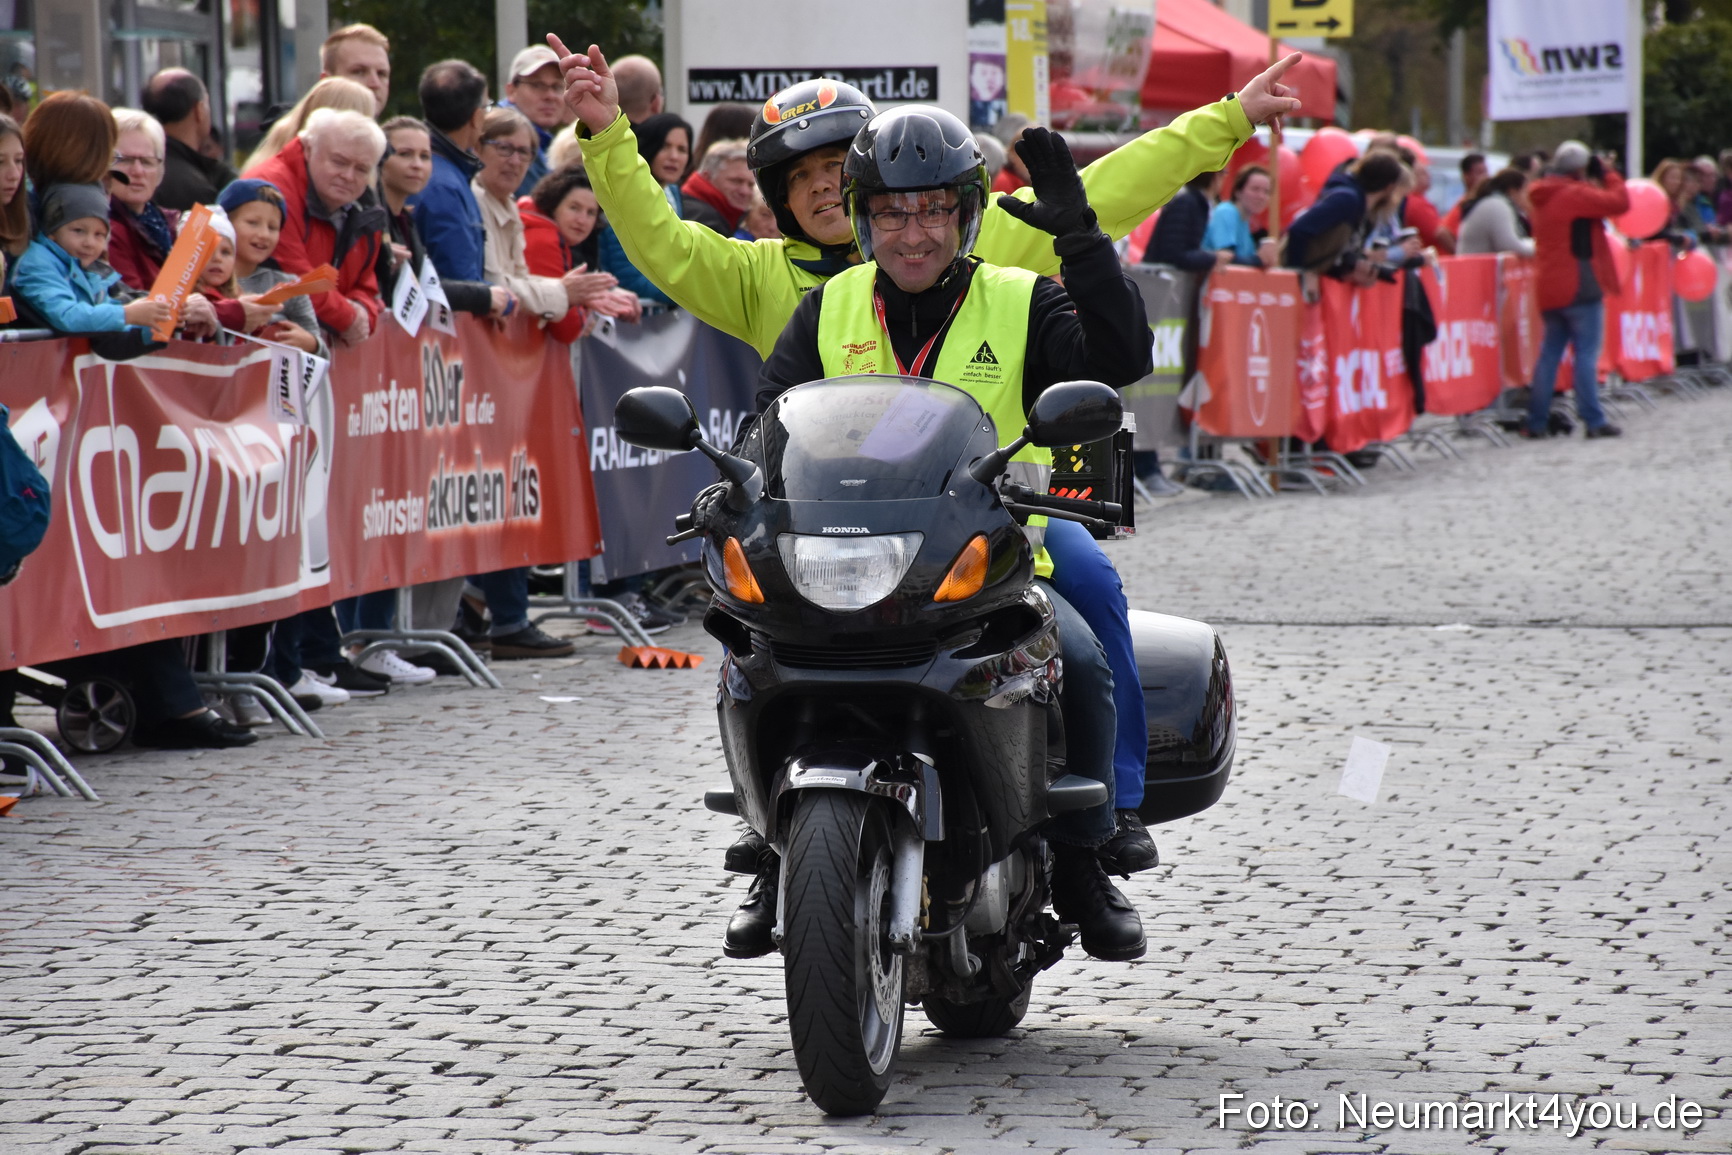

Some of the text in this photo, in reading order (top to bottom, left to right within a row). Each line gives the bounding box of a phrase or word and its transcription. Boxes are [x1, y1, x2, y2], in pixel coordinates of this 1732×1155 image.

[781, 100, 818, 121] GREX
[280, 356, 290, 399] swn
[822, 526, 871, 534] HONDA
